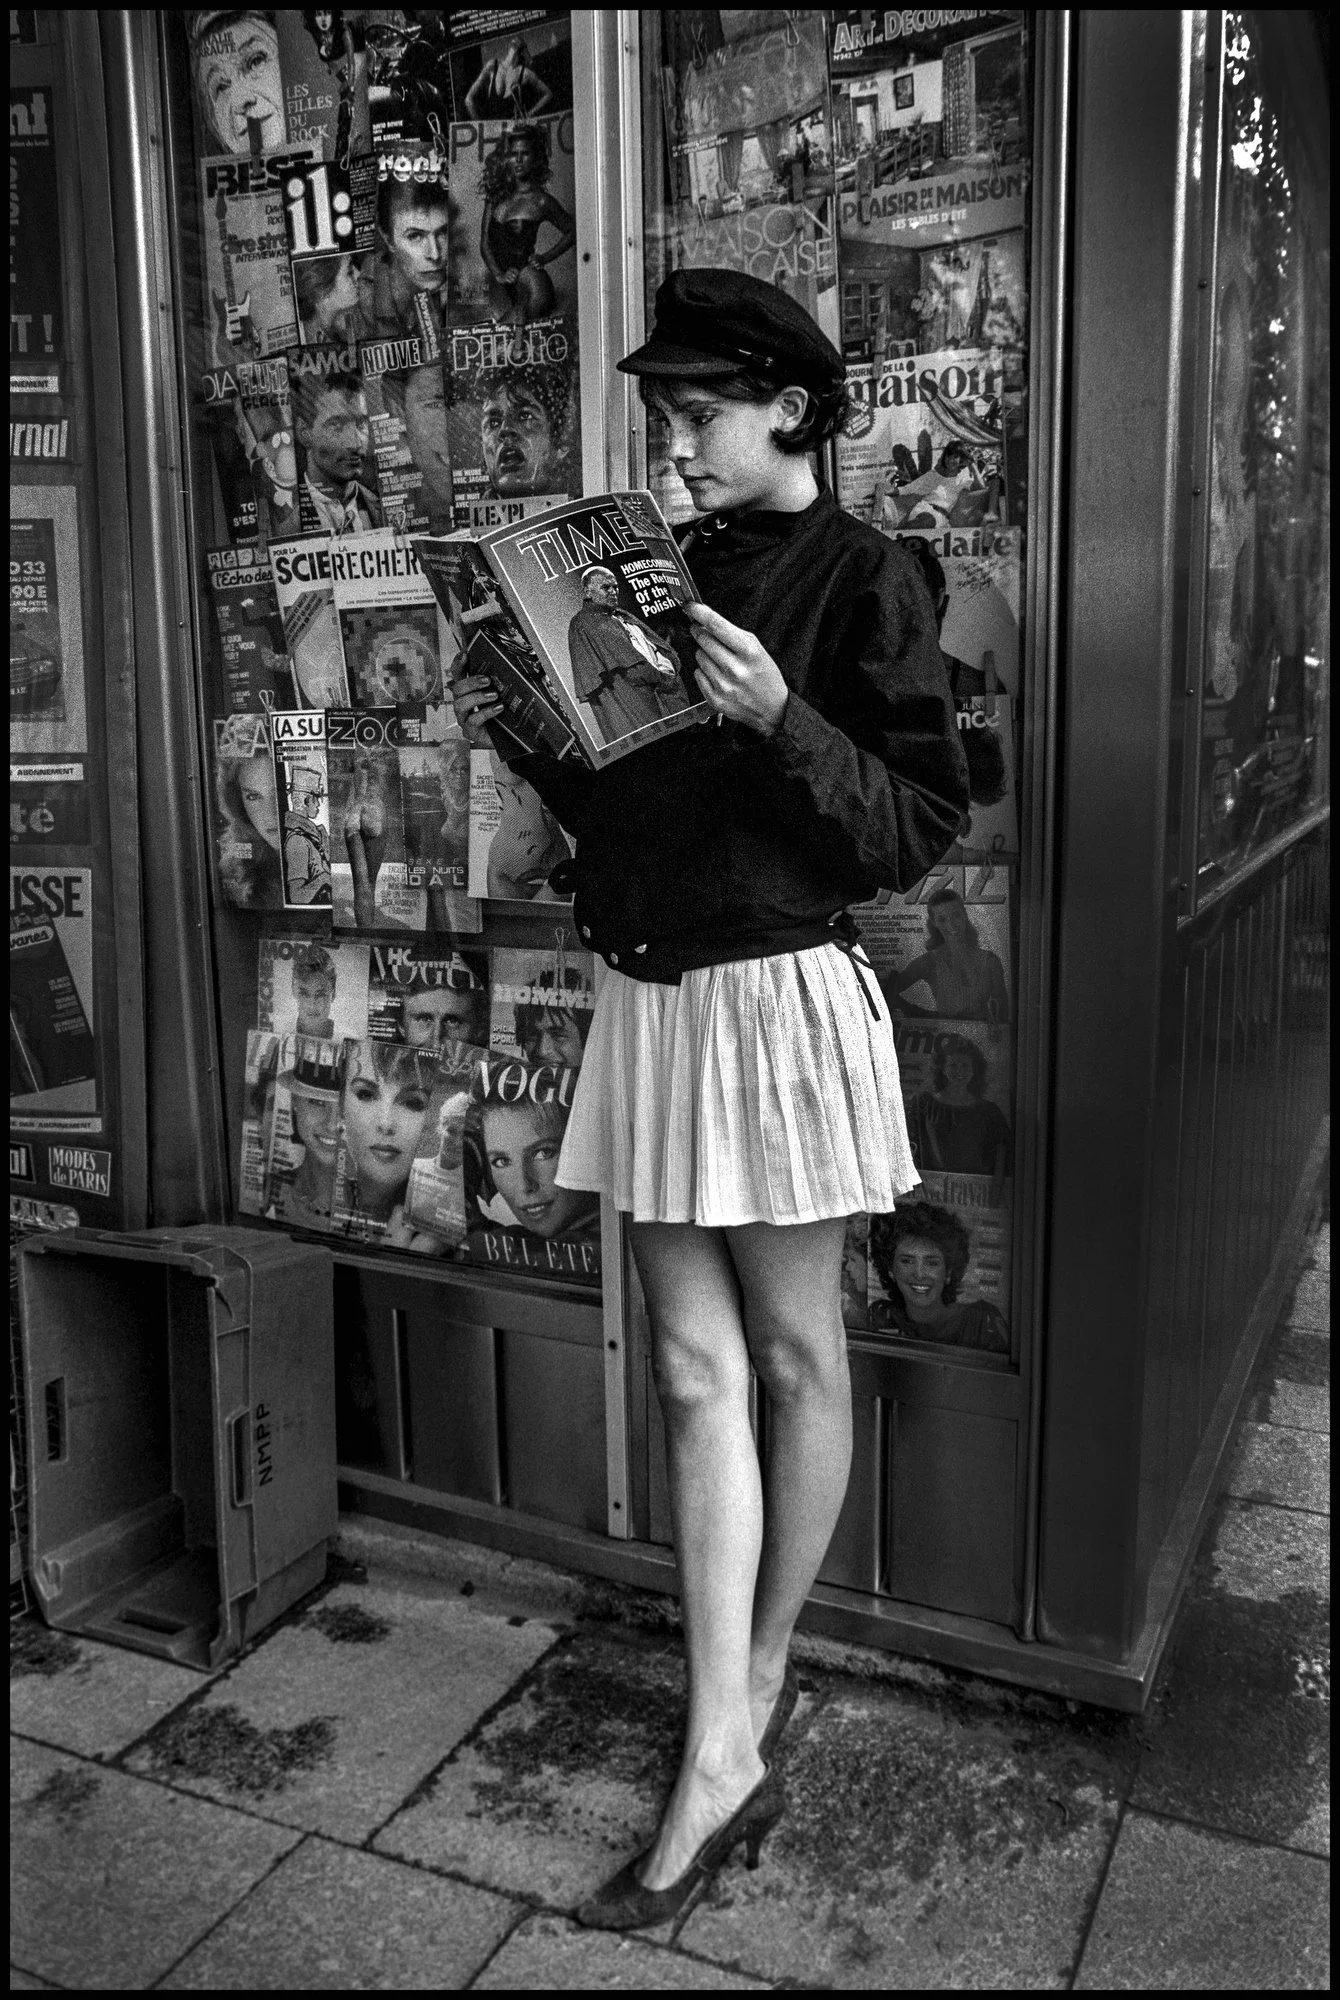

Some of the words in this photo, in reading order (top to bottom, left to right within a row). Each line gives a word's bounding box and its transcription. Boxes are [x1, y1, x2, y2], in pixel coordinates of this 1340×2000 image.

[287, 83, 309, 100] LES
[287, 95, 333, 115] FILLES
[288, 114, 307, 129] DU
[290, 124, 330, 144] ROCK
[450, 109, 574, 163] PHTO
[842, 191, 918, 224] PLAISIR
[921, 187, 933, 198] DE
[936, 175, 1022, 208] MAISON
[892, 219, 906, 230] LES
[908, 213, 939, 229] TABLES
[883, 363, 893, 373] DE
[895, 362, 905, 372] LA
[847, 360, 1000, 408] maison
[10, 418, 68, 458] rnal
[233, 514, 257, 527] S'ES
[273, 548, 287, 556] POUR
[289, 547, 297, 555] LA
[338, 545, 347, 553] LA
[516, 510, 648, 582] TIME
[928, 530, 1013, 558] claire
[275, 550, 332, 585] SCIE
[332, 547, 419, 581] RECHER
[620, 558, 677, 576] HOMECOMING
[627, 577, 651, 591] The
[649, 573, 681, 586] Return
[635, 589, 651, 604] Of
[651, 585, 669, 598] the
[641, 596, 677, 618] Polish
[17, 767, 74, 776] ABONNEMENT
[408, 866, 426, 875] LES
[432, 866, 464, 875] NUITS
[492, 1035, 516, 1046] SPORT
[52, 1147, 96, 1172] MODES
[53, 1167, 67, 1185] de
[68, 1168, 107, 1194] PARIS
[484, 1233, 538, 1267] BEL
[256, 1403, 273, 1487] NMPP
